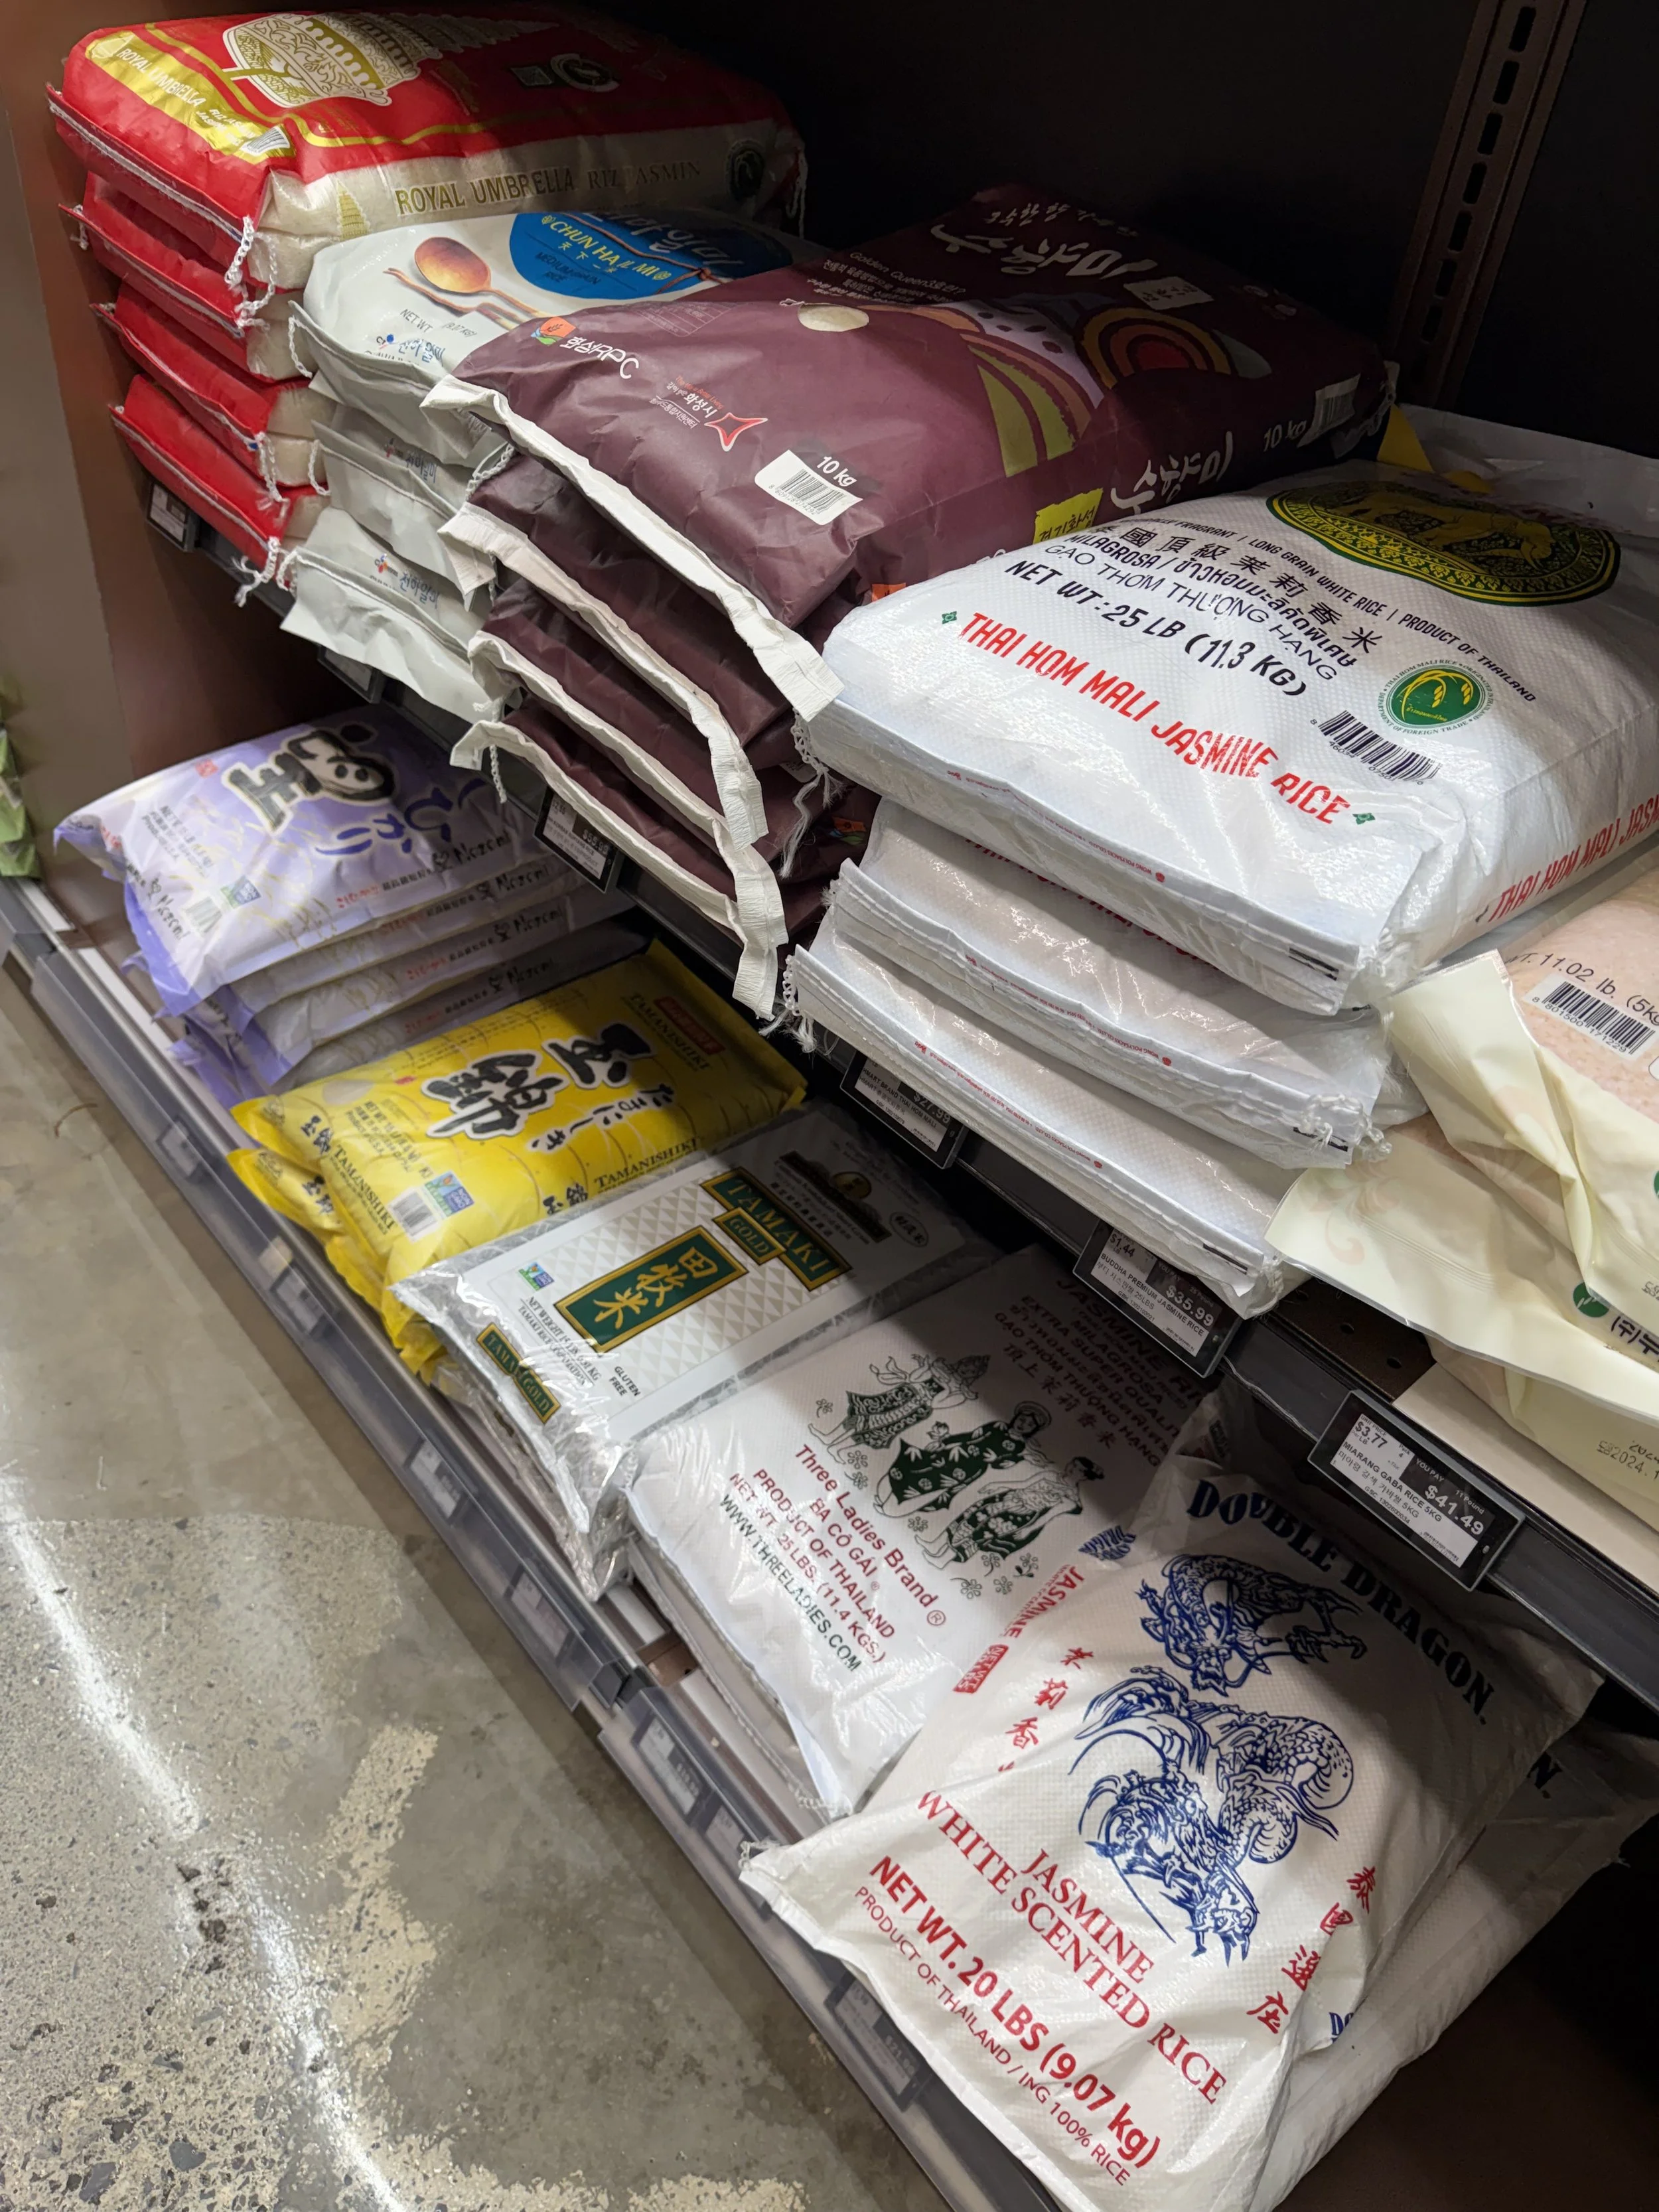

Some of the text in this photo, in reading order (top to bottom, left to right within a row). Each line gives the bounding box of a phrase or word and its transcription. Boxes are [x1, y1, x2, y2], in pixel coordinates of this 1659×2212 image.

[117, 49, 150, 74] ROYAL
[395, 167, 619, 214] ROYAL UMBRELLA RIZ
[549, 220, 598, 254] CHUN
[592, 246, 620, 267] HA
[632, 263, 660, 281] MI
[400, 309, 433, 333] NET WT
[684, 393, 718, 419] 화성시
[1263, 428, 1282, 453] 10
[816, 456, 858, 487] 10 kg
[1064, 534, 1161, 568] MILAGROSA
[1008, 559, 1063, 587] NET
[1142, 617, 1187, 638] LB
[1250, 654, 1307, 696] KG)
[1174, 520, 1537, 702] FRAGRANT LONG GRAIN WHITE RICE PRODUCT OF THAILAND
[956, 612, 1352, 825] THAI HOM MALI JASMINE RICE
[1440, 721, 1470, 733] TRADE
[1488, 818, 1621, 922] THAI HOM MALI
[1540, 952, 1618, 999] 11.02 lb.
[1544, 1003, 1583, 1027] 801500
[1589, 1027, 1628, 1054] 171229
[880, 1082, 899, 1099] BRAND
[899, 1096, 912, 1108] THAI
[910, 1105, 924, 1118] HOM
[923, 1115, 938, 1129] MALI
[593, 1136, 702, 1190] TAMANISHIKI
[725, 1179, 830, 1273] TAMAKI
[728, 1217, 770, 1254] GOLD
[1108, 1232, 1137, 1258] $1.44
[518, 1305, 540, 1331] TAMAKI
[1100, 1252, 1205, 1337] BUDDHA PREMIUM JASMINE RICE
[1135, 1290, 1156, 1310] 25LBS
[1165, 1284, 1215, 1328] $35.99
[538, 1309, 565, 1339] WEIGHT
[1020, 1293, 1072, 1339] EXTRA
[1068, 1335, 1126, 1386] SUPER
[609, 1376, 628, 1396] FREE
[614, 1365, 642, 1397] GLUTEN
[1066, 1317, 1169, 1406] MILAGROSA
[523, 1376, 551, 1414] GOLD
[1354, 1420, 1388, 1449] $3.77
[1359, 1434, 1369, 1446] LB
[1342, 1441, 1443, 1523] MIARANG GABA RICE 5KG
[1364, 1485, 1379, 1501] GSC
[1415, 1457, 1431, 1475] YOU
[1429, 1469, 1445, 1483] PAY
[1462, 1495, 1486, 1515] Pound
[794, 1443, 940, 1610] Three Ladies Brand
[1187, 1478, 1344, 1574] DOUBLE
[1402, 1501, 1421, 1519] 5KG
[1424, 1484, 1485, 1536] $41.49
[753, 1467, 895, 1639] PRODUCT OF THAILAND
[809, 1497, 833, 1522] BA
[848, 1546, 879, 1578] GÁI
[776, 1532, 796, 1552] 25
[816, 1582, 851, 1622] (11.4
[847, 1619, 886, 1664] KGS.)
[1005, 1566, 1086, 1639] JASMINE
[1021, 1848, 1155, 1984] JASMINE
[916, 1789, 1227, 2104] WHITE SCENTED RICE
[854, 1885, 922, 1963] PRODUCT
[916, 1961, 942, 1988] OF
[937, 1984, 1012, 2065] THAILAND
[1018, 2071, 1051, 2104] ING
[1048, 2102, 1093, 2148] 100%
[1090, 2145, 1131, 2187] RICE
[868, 1855, 928, 1915] NET
[916, 1904, 968, 1969] WT.
[958, 1956, 997, 1998] 20
[990, 1987, 1050, 2052] LBS
[1039, 2041, 1117, 2112] (9.07
[1107, 2101, 1161, 2170] kg)
